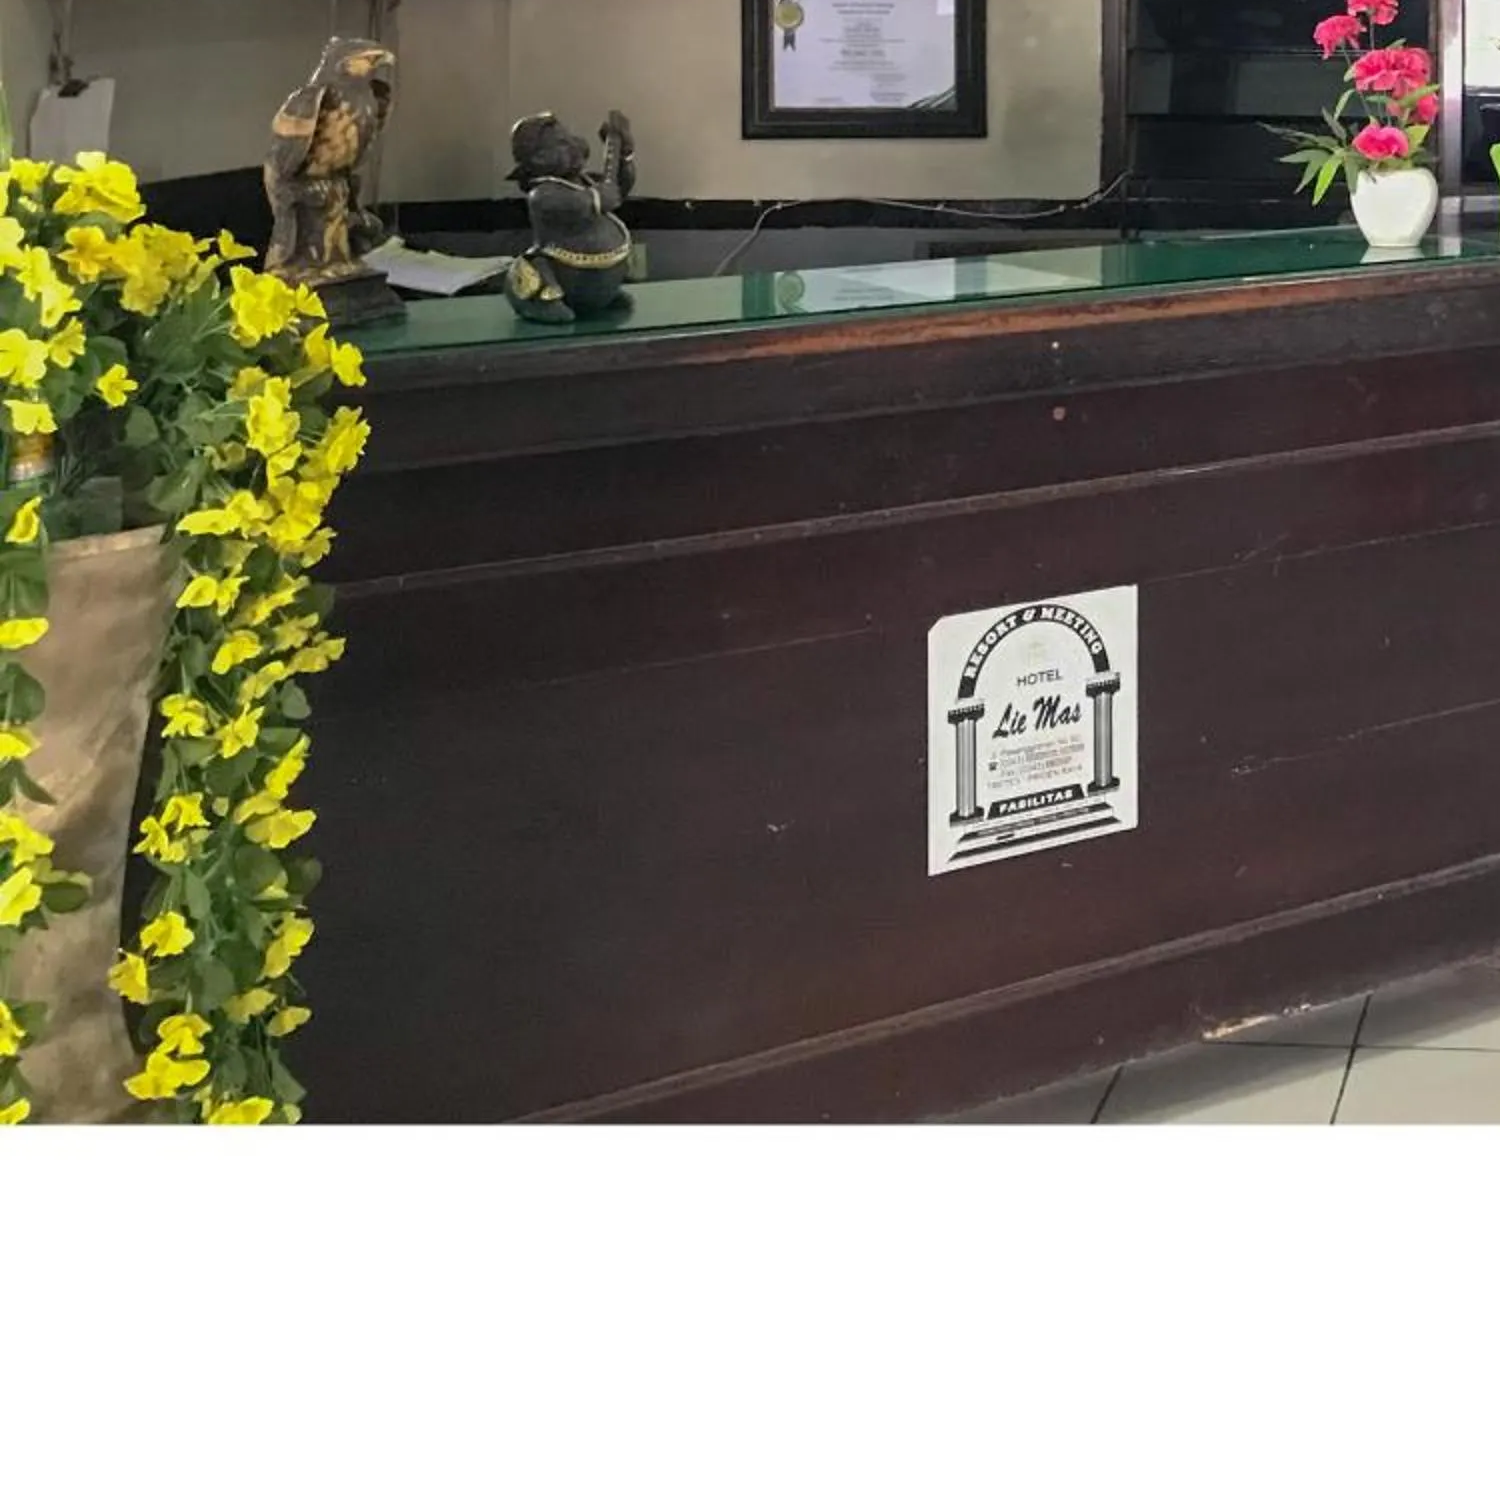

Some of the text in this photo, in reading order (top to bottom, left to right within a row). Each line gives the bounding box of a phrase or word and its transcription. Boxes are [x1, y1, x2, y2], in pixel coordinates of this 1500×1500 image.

[1039, 607, 1103, 655] MEETING
[1017, 669, 1063, 687] HOTEL
[992, 694, 1083, 739] Lie Mas
